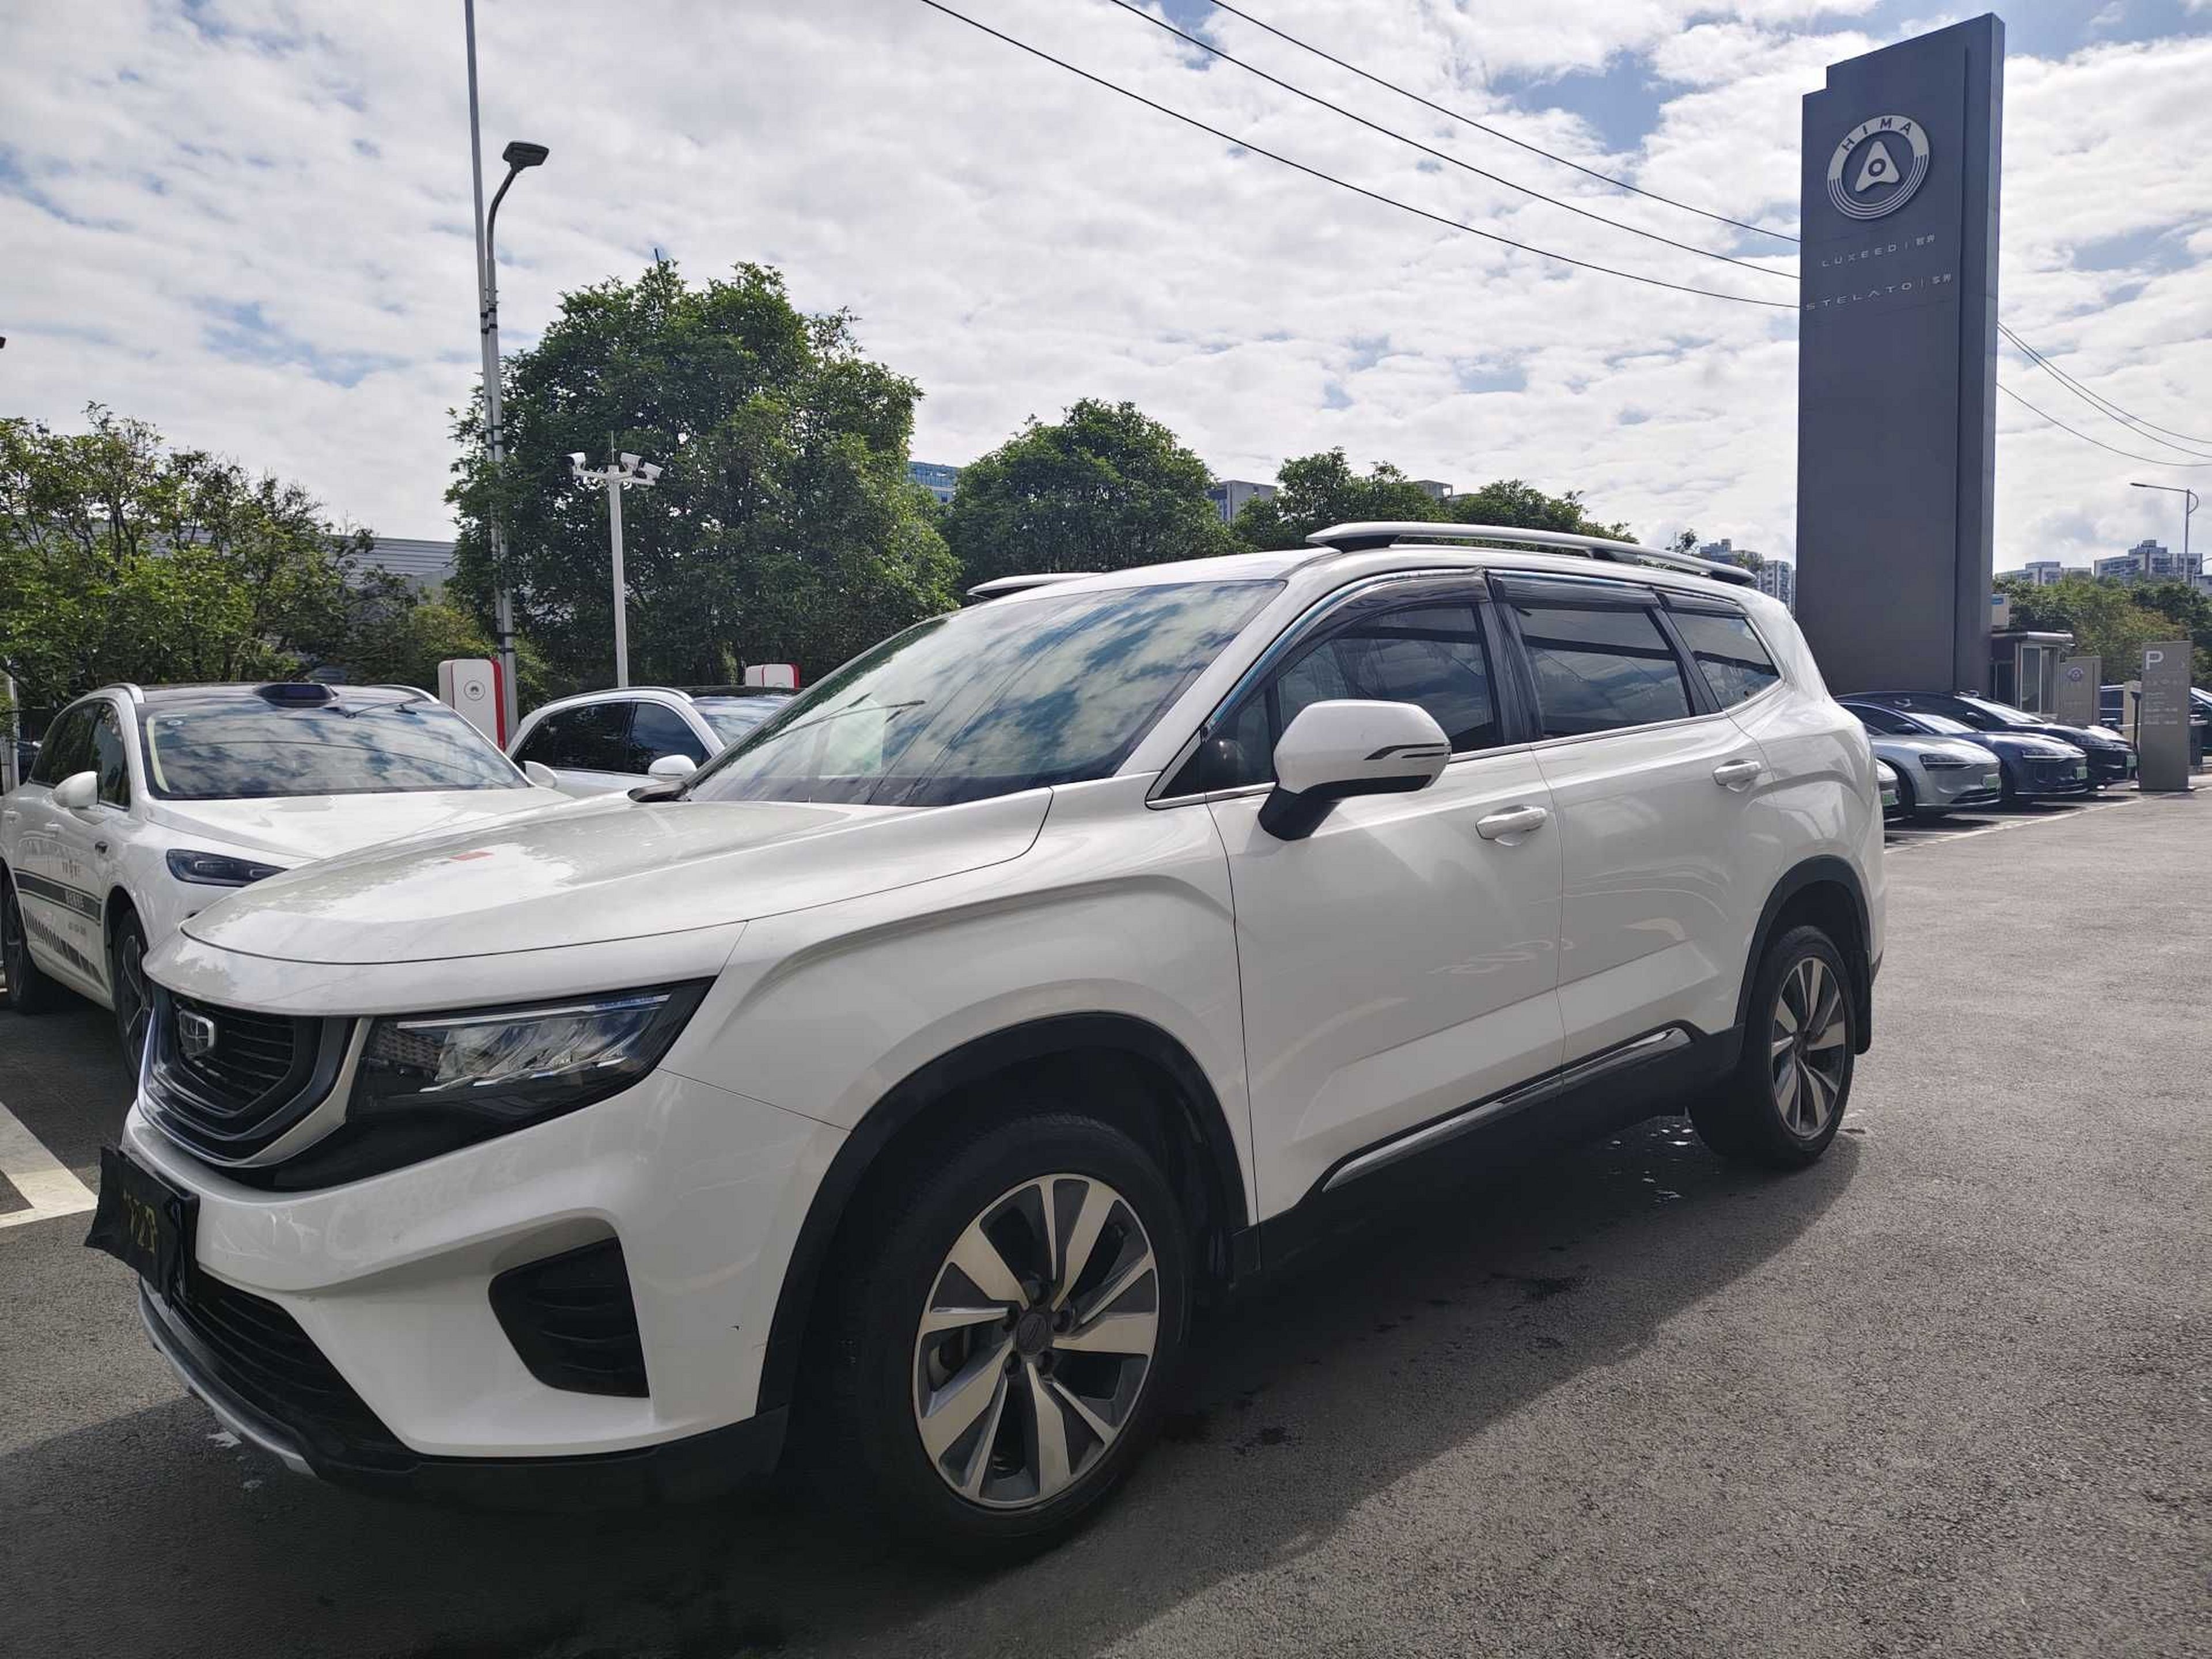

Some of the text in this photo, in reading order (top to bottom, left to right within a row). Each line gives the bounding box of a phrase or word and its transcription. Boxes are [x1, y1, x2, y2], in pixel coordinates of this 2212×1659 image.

[1842, 118, 1912, 151] HIMA
[1822, 244, 1897, 267] LUXEED
[1806, 282, 1912, 310] STELATO
[2146, 650, 2164, 670] P
